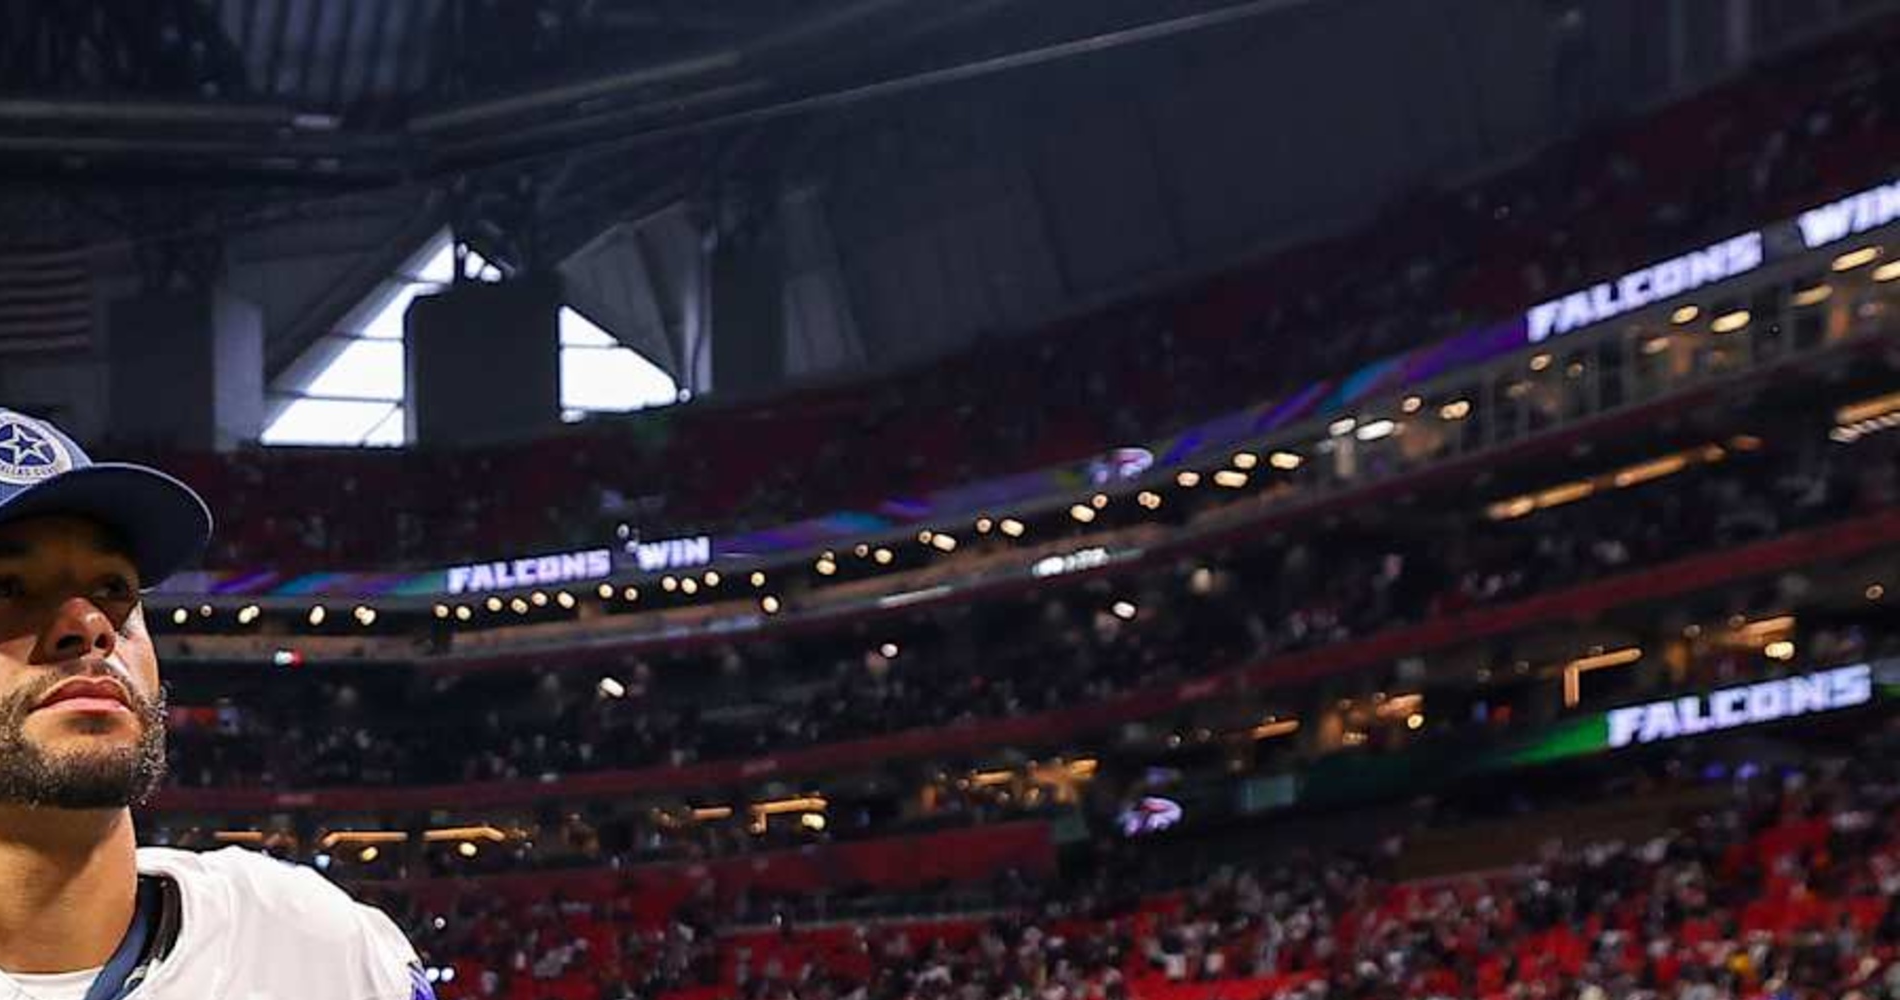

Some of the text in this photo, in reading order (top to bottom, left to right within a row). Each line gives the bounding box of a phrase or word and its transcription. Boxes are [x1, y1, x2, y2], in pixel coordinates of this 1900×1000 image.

[1527, 231, 1763, 342] FALCONS
[447, 537, 710, 594] FALCONS WIN
[1608, 664, 1871, 747] FALCONS
